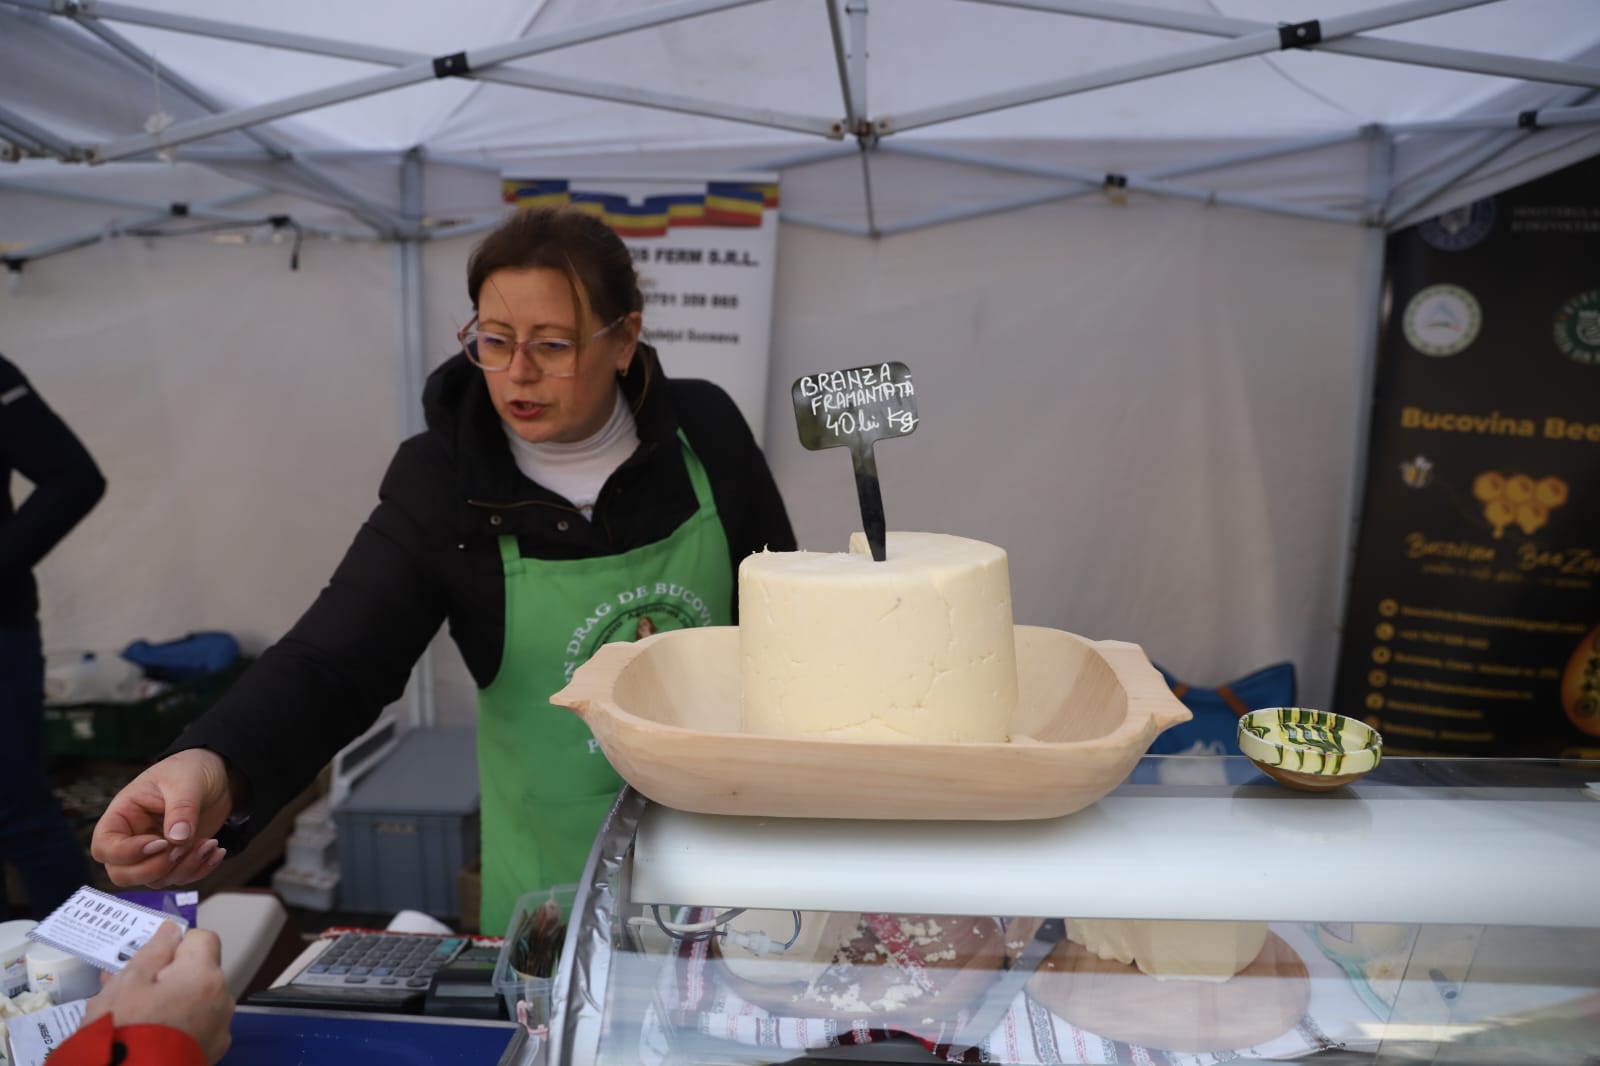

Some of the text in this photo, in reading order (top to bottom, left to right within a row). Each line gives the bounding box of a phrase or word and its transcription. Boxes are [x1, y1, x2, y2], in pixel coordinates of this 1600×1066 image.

[655, 248, 702, 264] FERM
[709, 250, 759, 267] S.R.L.
[826, 412, 856, 436] 40
[1402, 407, 1536, 437] Bucovina
[567, 602, 611, 656] DRAG
[617, 585, 649, 604] DE
[75, 896, 138, 926] TOMBOLA
